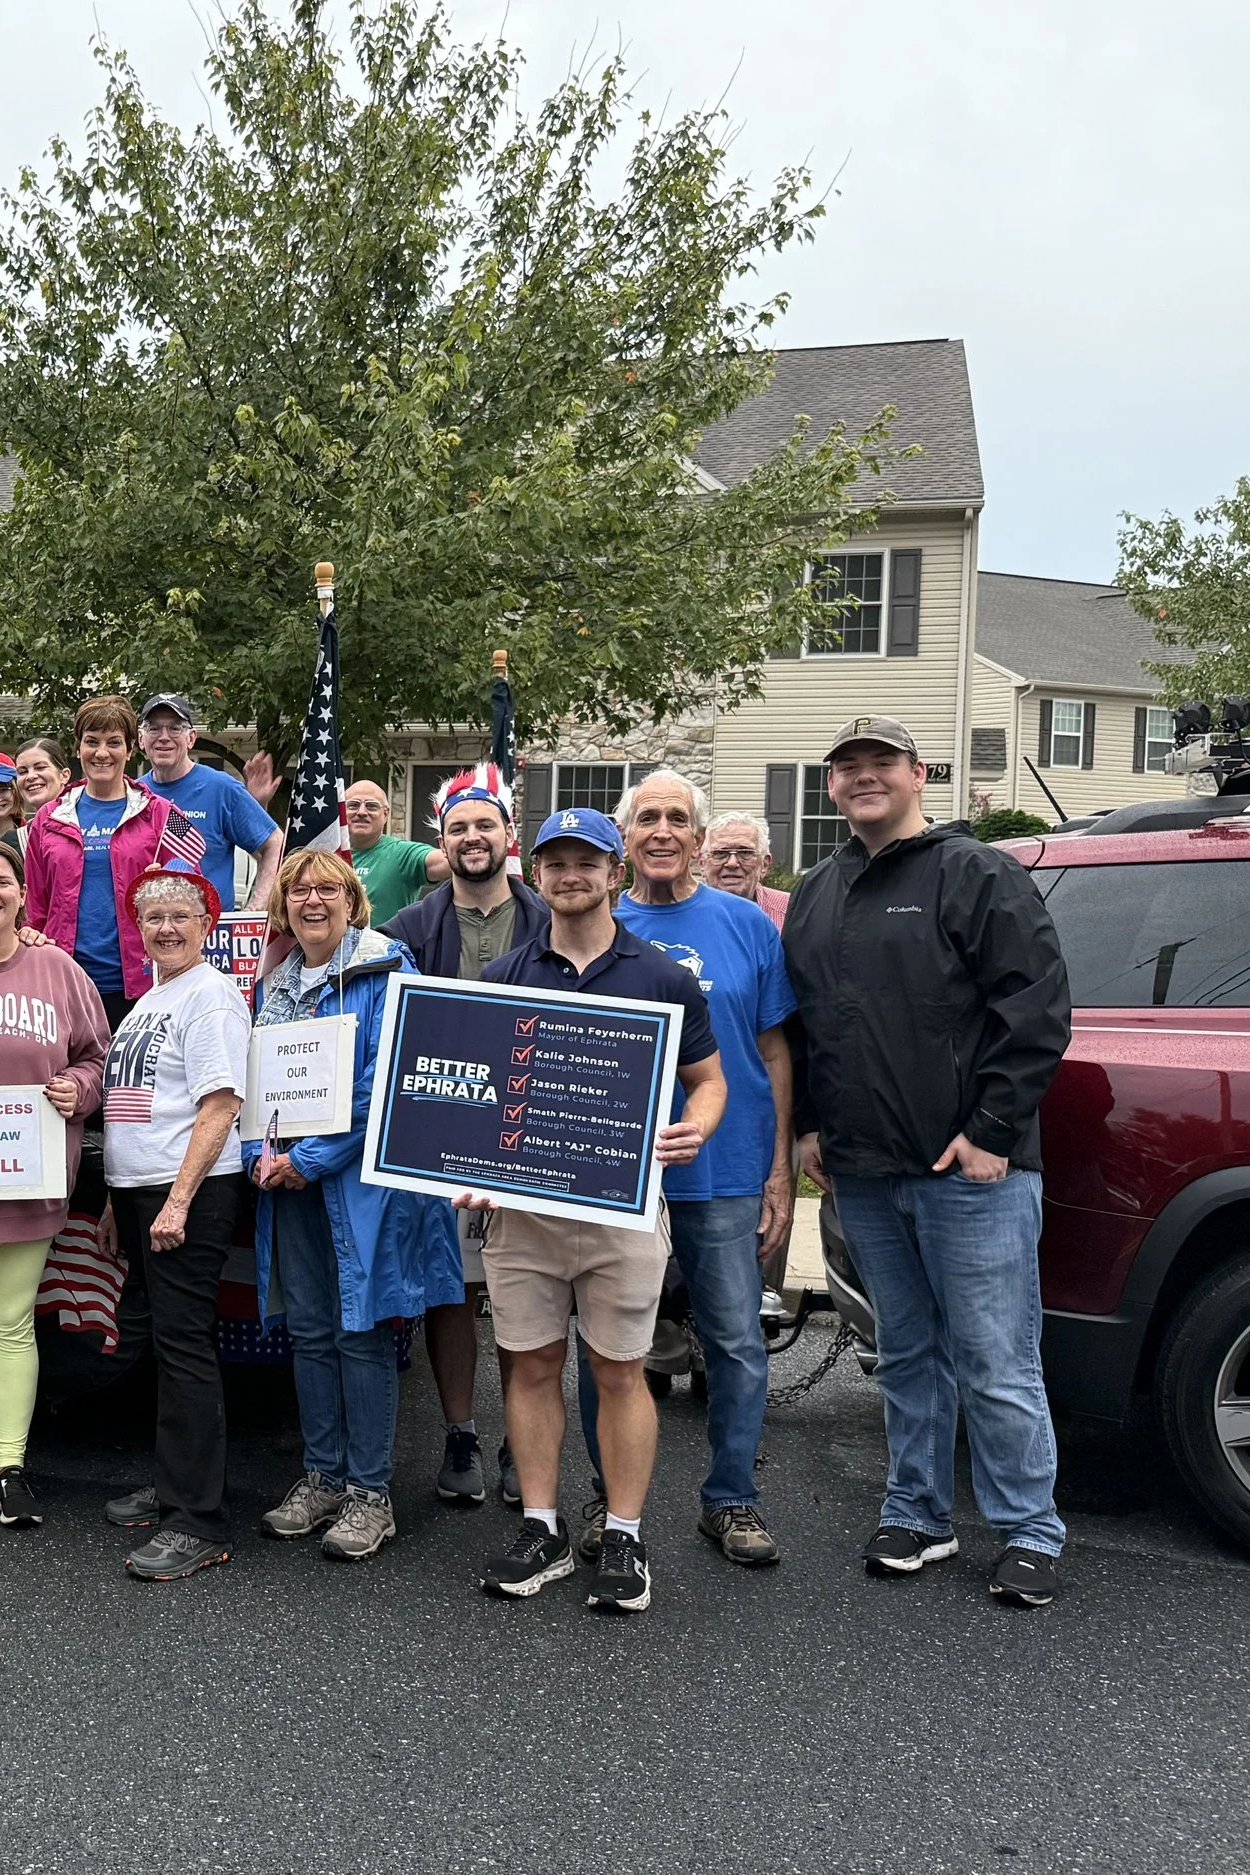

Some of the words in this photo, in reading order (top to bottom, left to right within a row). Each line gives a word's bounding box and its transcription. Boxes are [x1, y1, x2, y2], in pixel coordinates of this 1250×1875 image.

[892, 904, 922, 913] Columbia
[234, 925, 253, 934] ALL
[35, 1034, 48, 1047] DE
[538, 1031, 566, 1042] Mayor
[568, 1035, 578, 1043] of
[580, 1036, 618, 1048] Ephrata
[539, 1020, 584, 1034] Rumina
[588, 1026, 654, 1043] Feyerherm
[277, 1041, 321, 1056] PROTECT
[535, 1049, 565, 1061] Kalie
[568, 1054, 619, 1068] Johnson
[286, 1066, 308, 1079] OUR
[415, 1056, 491, 1081] BETTER
[534, 1060, 573, 1072] Borough
[576, 1065, 615, 1078] Council,
[617, 1071, 631, 1079] 1W
[265, 1087, 329, 1102] ENVIRONMENT
[402, 1074, 499, 1103] EPHRATA
[530, 1078, 565, 1091] Jason
[569, 1081, 608, 1097] Rieker
[530, 1089, 569, 1102] Borough
[572, 1094, 611, 1107] Council,
[613, 1100, 629, 1109] 2W
[526, 1118, 565, 1130] Borough
[568, 1123, 607, 1136] Council,
[609, 1129, 625, 1138] 3W
[527, 1107, 556, 1117] Smath
[559, 1111, 643, 1130] Pierre-Bellegarde
[522, 1146, 562, 1159] Borough
[564, 1151, 603, 1165] Council,
[605, 1158, 622, 1167] 4W
[523, 1135, 561, 1148] Albert
[595, 1146, 638, 1160] Cobian
[440, 1152, 577, 1180] EphrataDems.org/BetterEphrata
